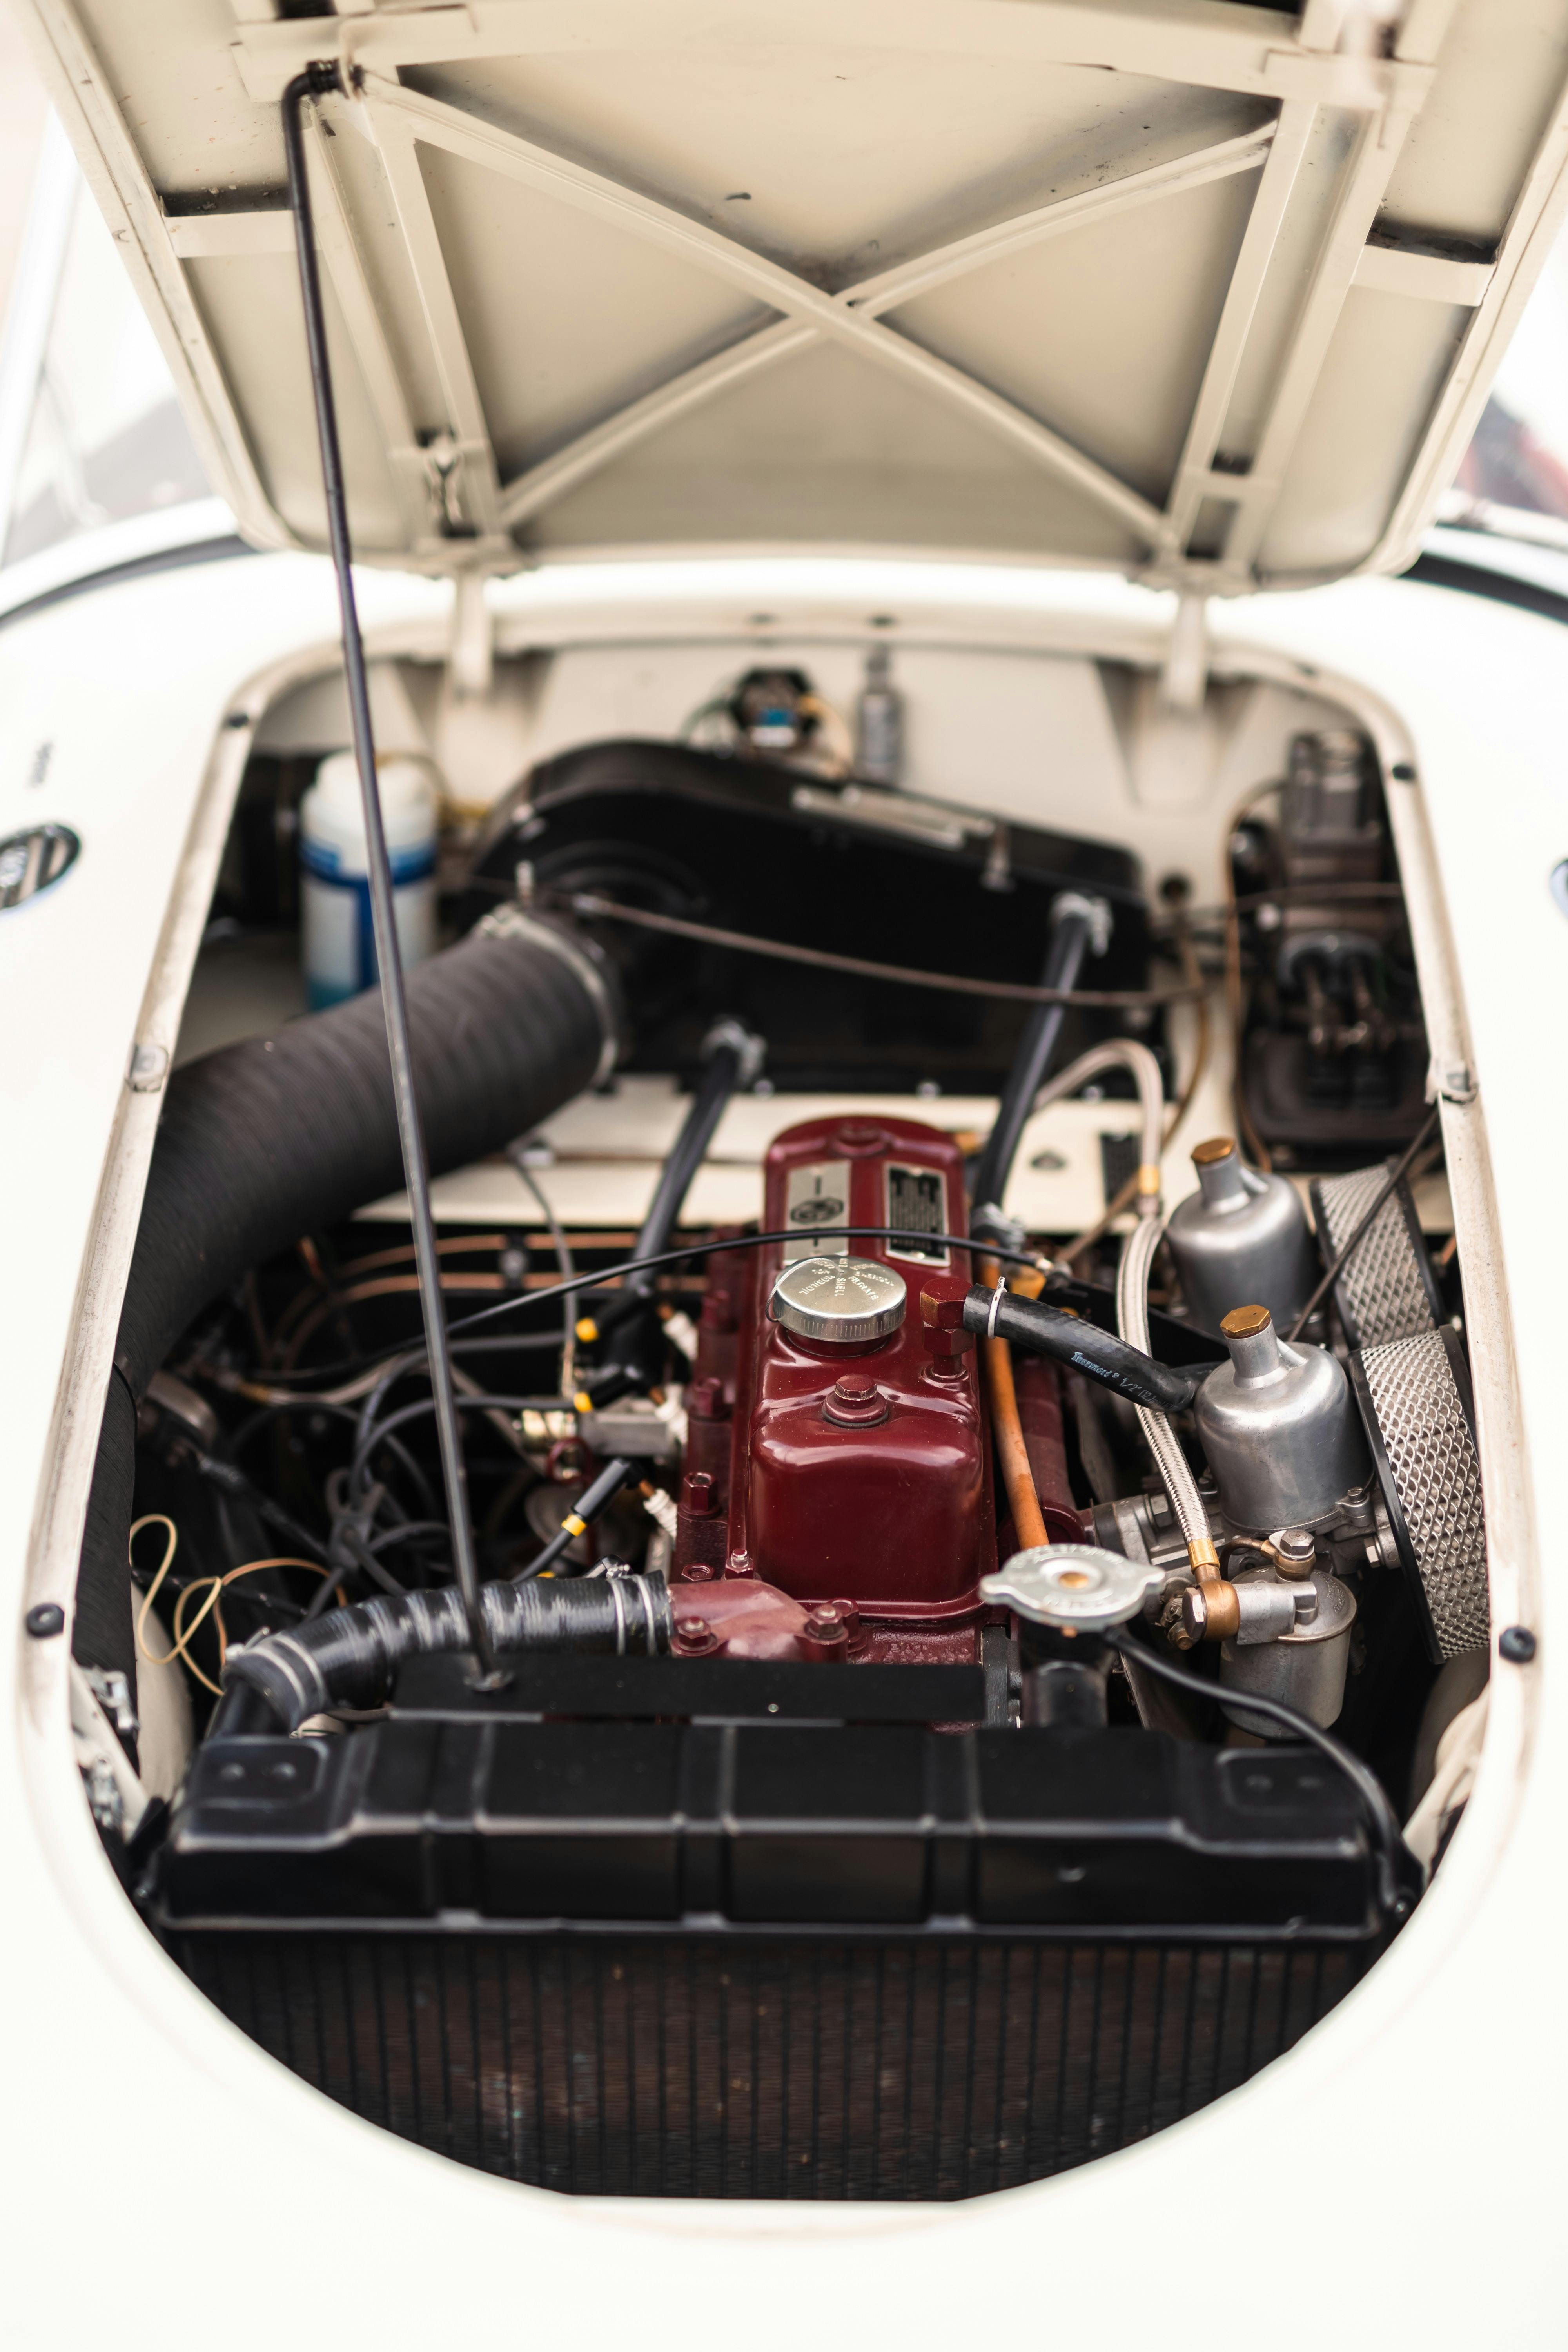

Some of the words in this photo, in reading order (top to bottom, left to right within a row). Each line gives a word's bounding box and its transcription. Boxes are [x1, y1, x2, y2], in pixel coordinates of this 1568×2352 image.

[799, 1275, 835, 1295] MOBILOIL
[834, 1278, 846, 1297] SHELL
[848, 1276, 879, 1300] FILTRATE
